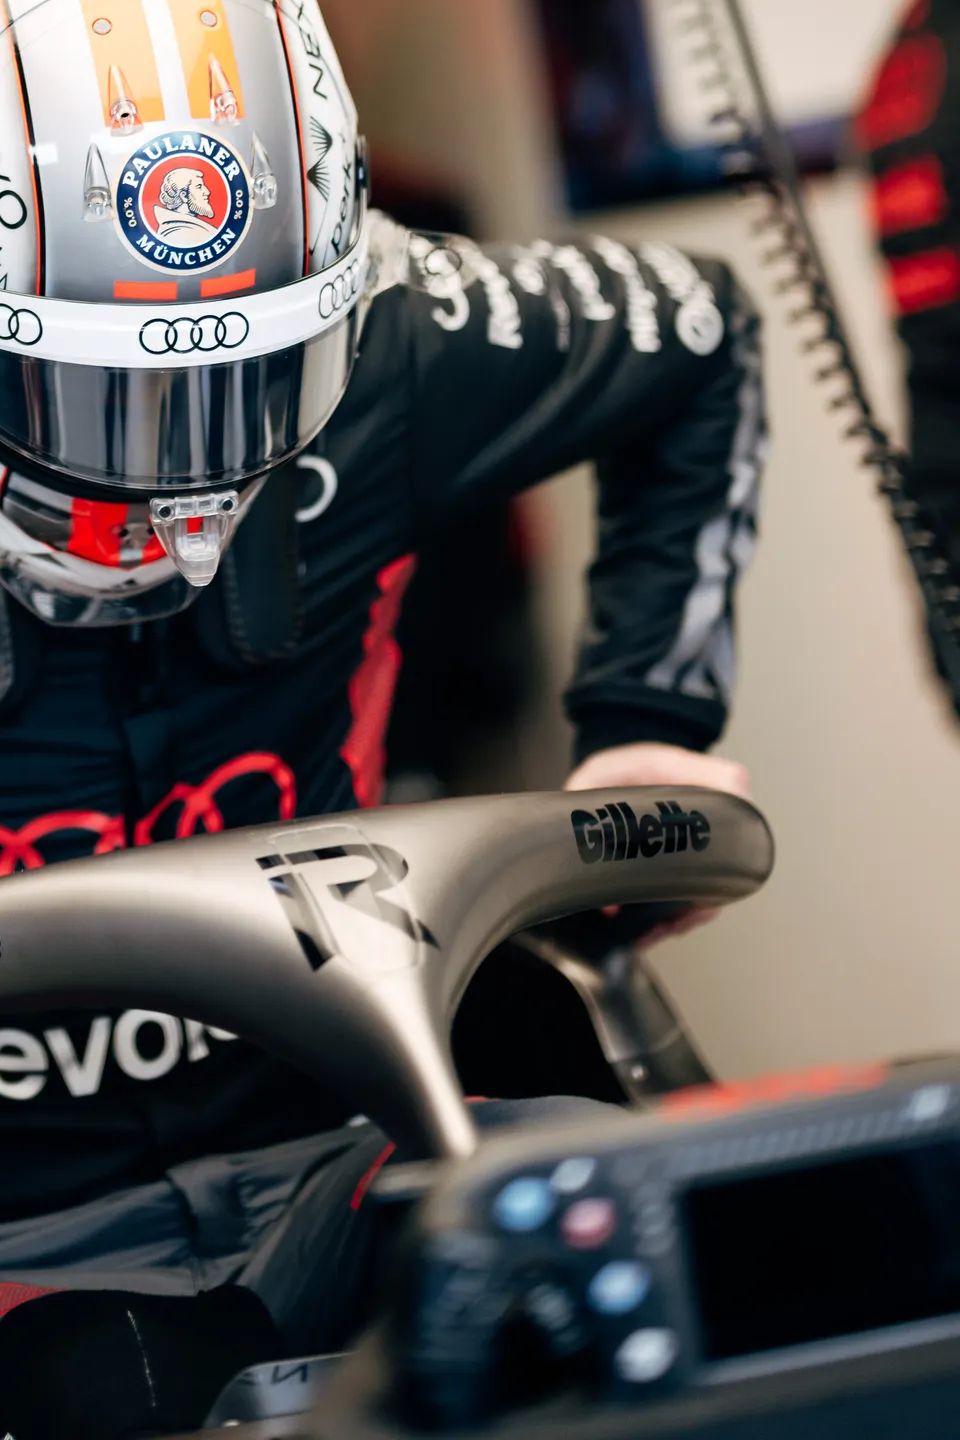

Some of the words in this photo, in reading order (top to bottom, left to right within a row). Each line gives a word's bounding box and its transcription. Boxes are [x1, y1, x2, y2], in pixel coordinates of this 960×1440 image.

[122, 134, 241, 189] PAULANER
[136, 228, 237, 266] MÜNCHEN
[571, 800, 711, 865] Gillette
